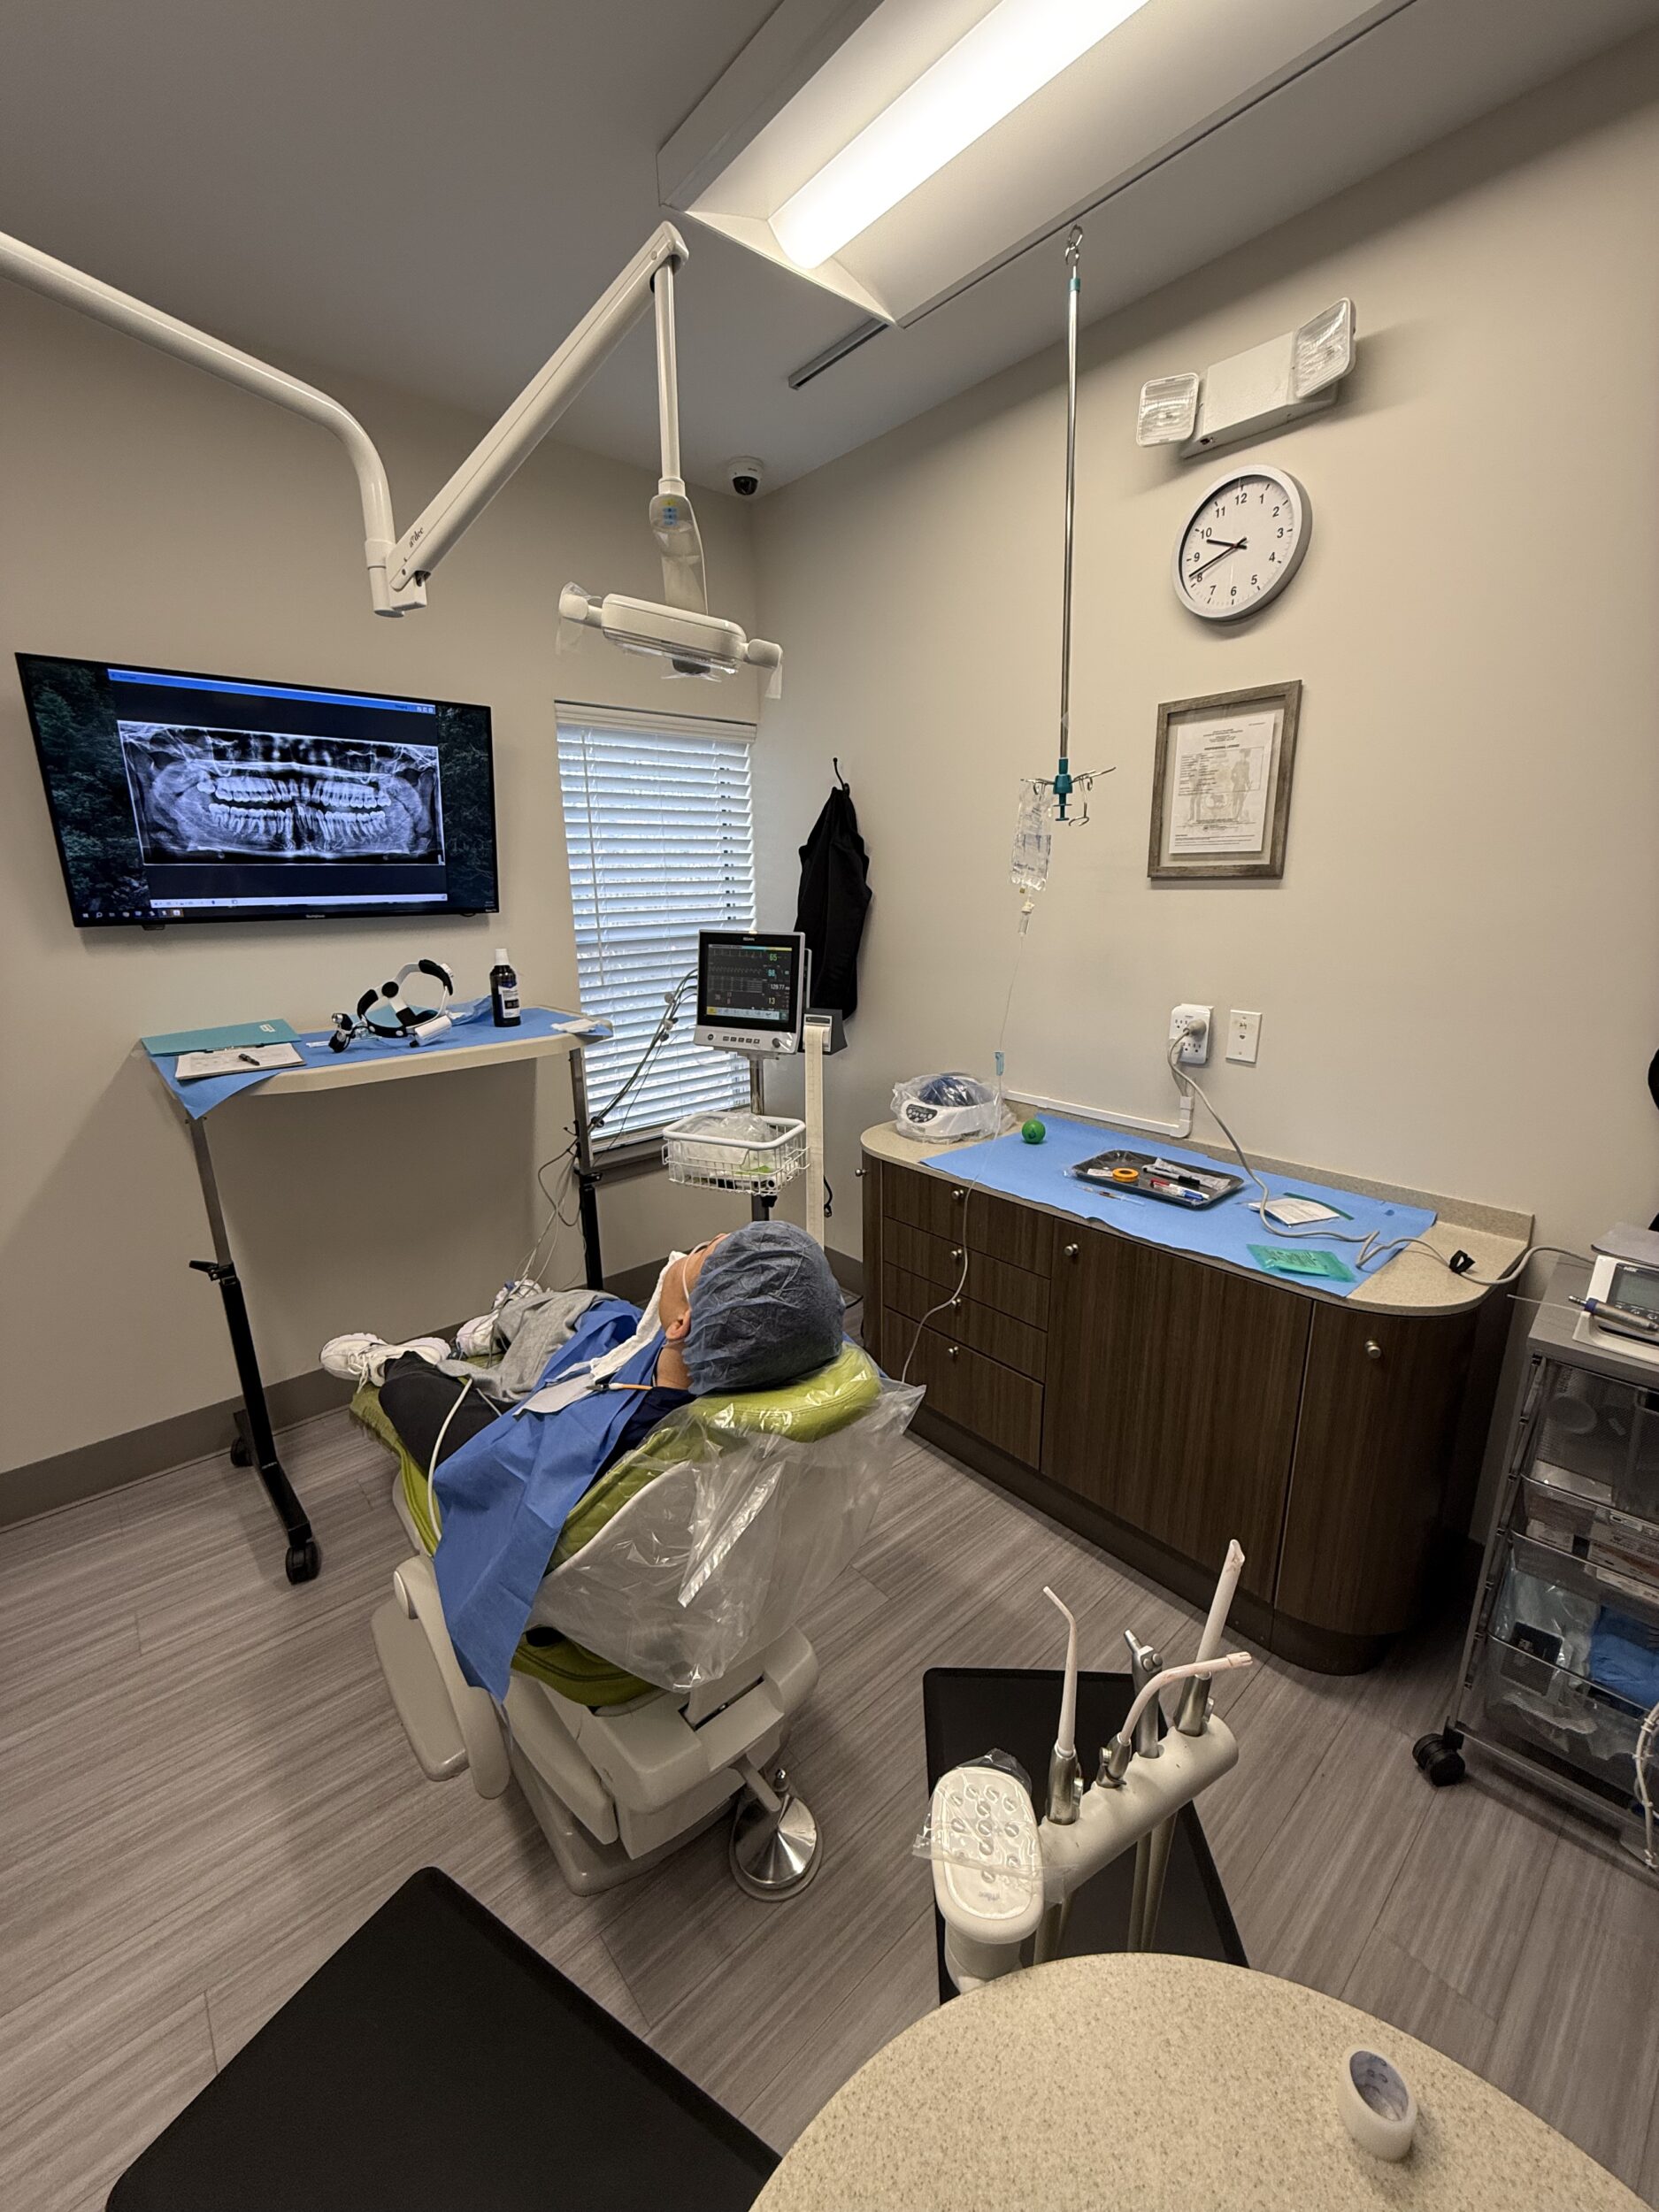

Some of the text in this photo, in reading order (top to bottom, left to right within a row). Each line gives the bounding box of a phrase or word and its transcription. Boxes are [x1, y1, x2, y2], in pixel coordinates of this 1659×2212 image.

[1234, 493, 1248, 505] 12
[1259, 493, 1264, 504] 1
[1215, 506, 1225, 518] 11
[1272, 506, 1280, 518] 2
[1200, 527, 1212, 540] 10
[1277, 527, 1284, 539] 3
[1194, 552, 1201, 562] 9
[1269, 552, 1276, 563] 4
[1196, 572, 1203, 583] 8
[1250, 574, 1258, 586] 5
[1210, 585, 1217, 595] 7
[1230, 586, 1237, 596] 6
